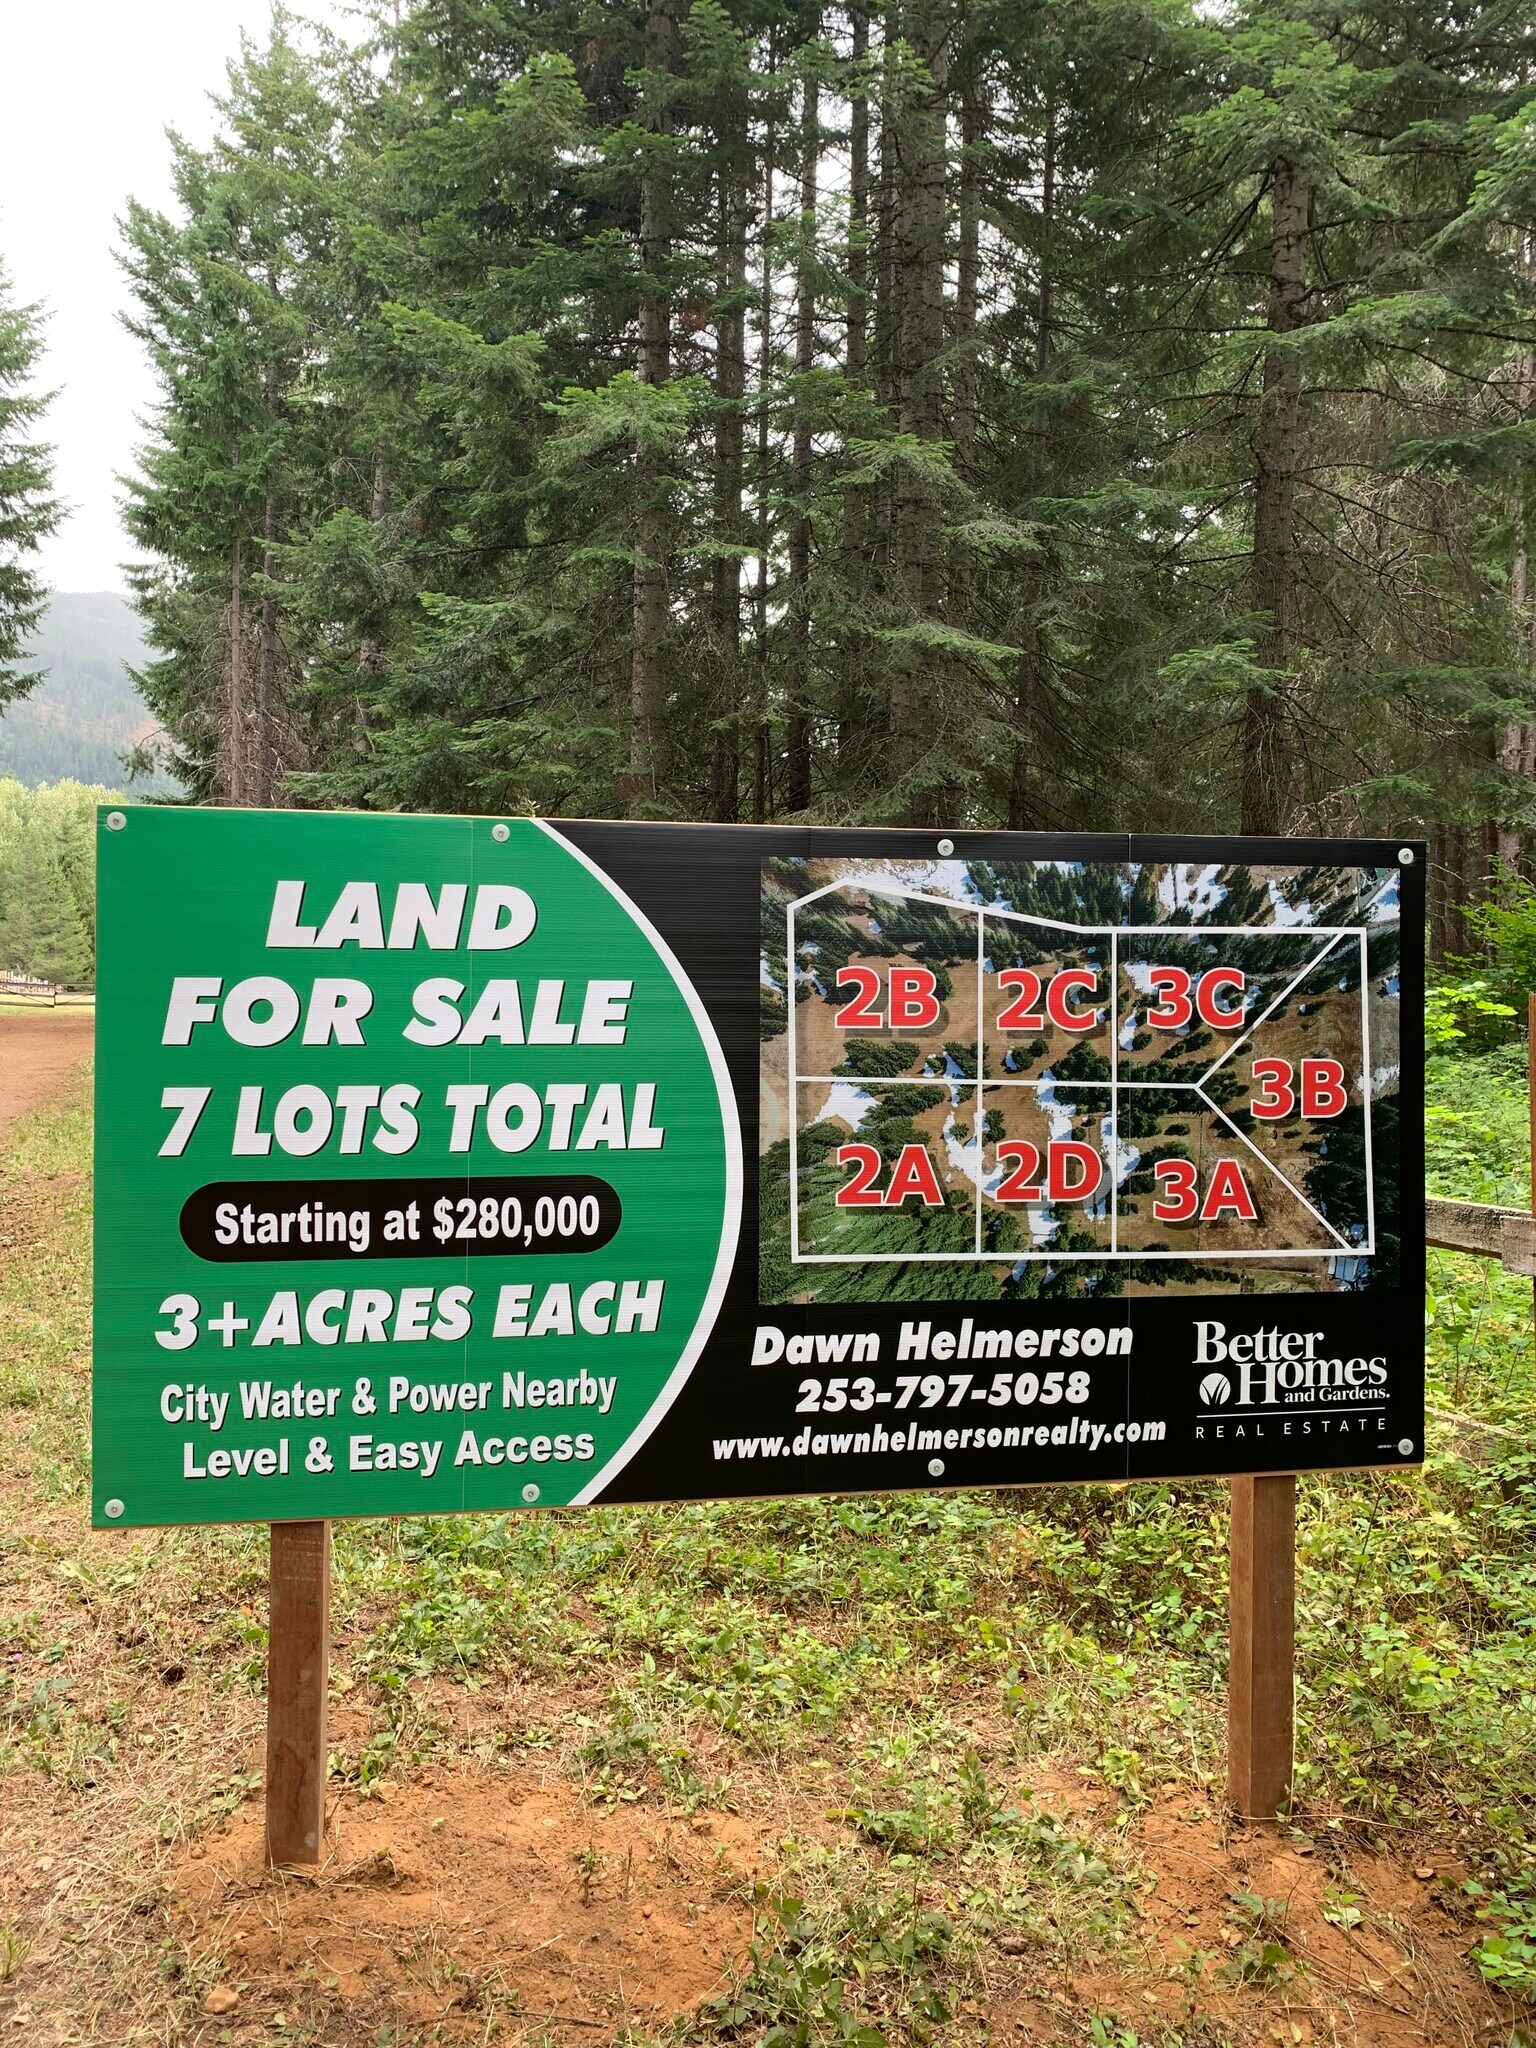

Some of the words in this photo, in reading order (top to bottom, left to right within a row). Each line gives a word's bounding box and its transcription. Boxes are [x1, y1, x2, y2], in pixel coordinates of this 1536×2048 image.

[265, 880, 537, 950] LAND
[161, 975, 373, 1047] FOR
[401, 977, 634, 1047] SALE
[835, 966, 939, 1028] 2B
[997, 968, 1096, 1031] 2C
[1147, 967, 1244, 1029] 3C
[1251, 1058, 1347, 1119] 3B
[157, 1086, 212, 1157] 7
[231, 1083, 422, 1156] LOTS
[444, 1082, 664, 1153] TOTAL
[836, 1144, 942, 1206] 2A
[995, 1140, 1103, 1202] 2D
[1153, 1159, 1255, 1221] 3A
[214, 1201, 370, 1253] Starting
[383, 1200, 421, 1241] at
[432, 1194, 600, 1248] $280,000
[492, 1279, 665, 1338] EACH
[750, 1325, 881, 1366] Dawn
[896, 1318, 1134, 1361] Helmerson
[1191, 1320, 1325, 1364] Better
[160, 1383, 230, 1431] City
[239, 1380, 342, 1419] Water
[351, 1376, 377, 1415] &
[389, 1376, 493, 1413] Power
[502, 1368, 617, 1414] Nearby
[795, 1370, 1091, 1413] 253-797-5058
[1234, 1356, 1388, 1405] Homes
[1284, 1387, 1315, 1403] and
[1318, 1385, 1391, 1402] Gardens.
[183, 1438, 289, 1478] Level
[304, 1436, 335, 1473] &
[349, 1434, 443, 1477] Easy
[453, 1430, 595, 1466] Access
[712, 1416, 1167, 1460] www.dawnhelmersonrealty.com
[1196, 1423, 1265, 1439] REAL
[1283, 1417, 1386, 1435] ESTATE
